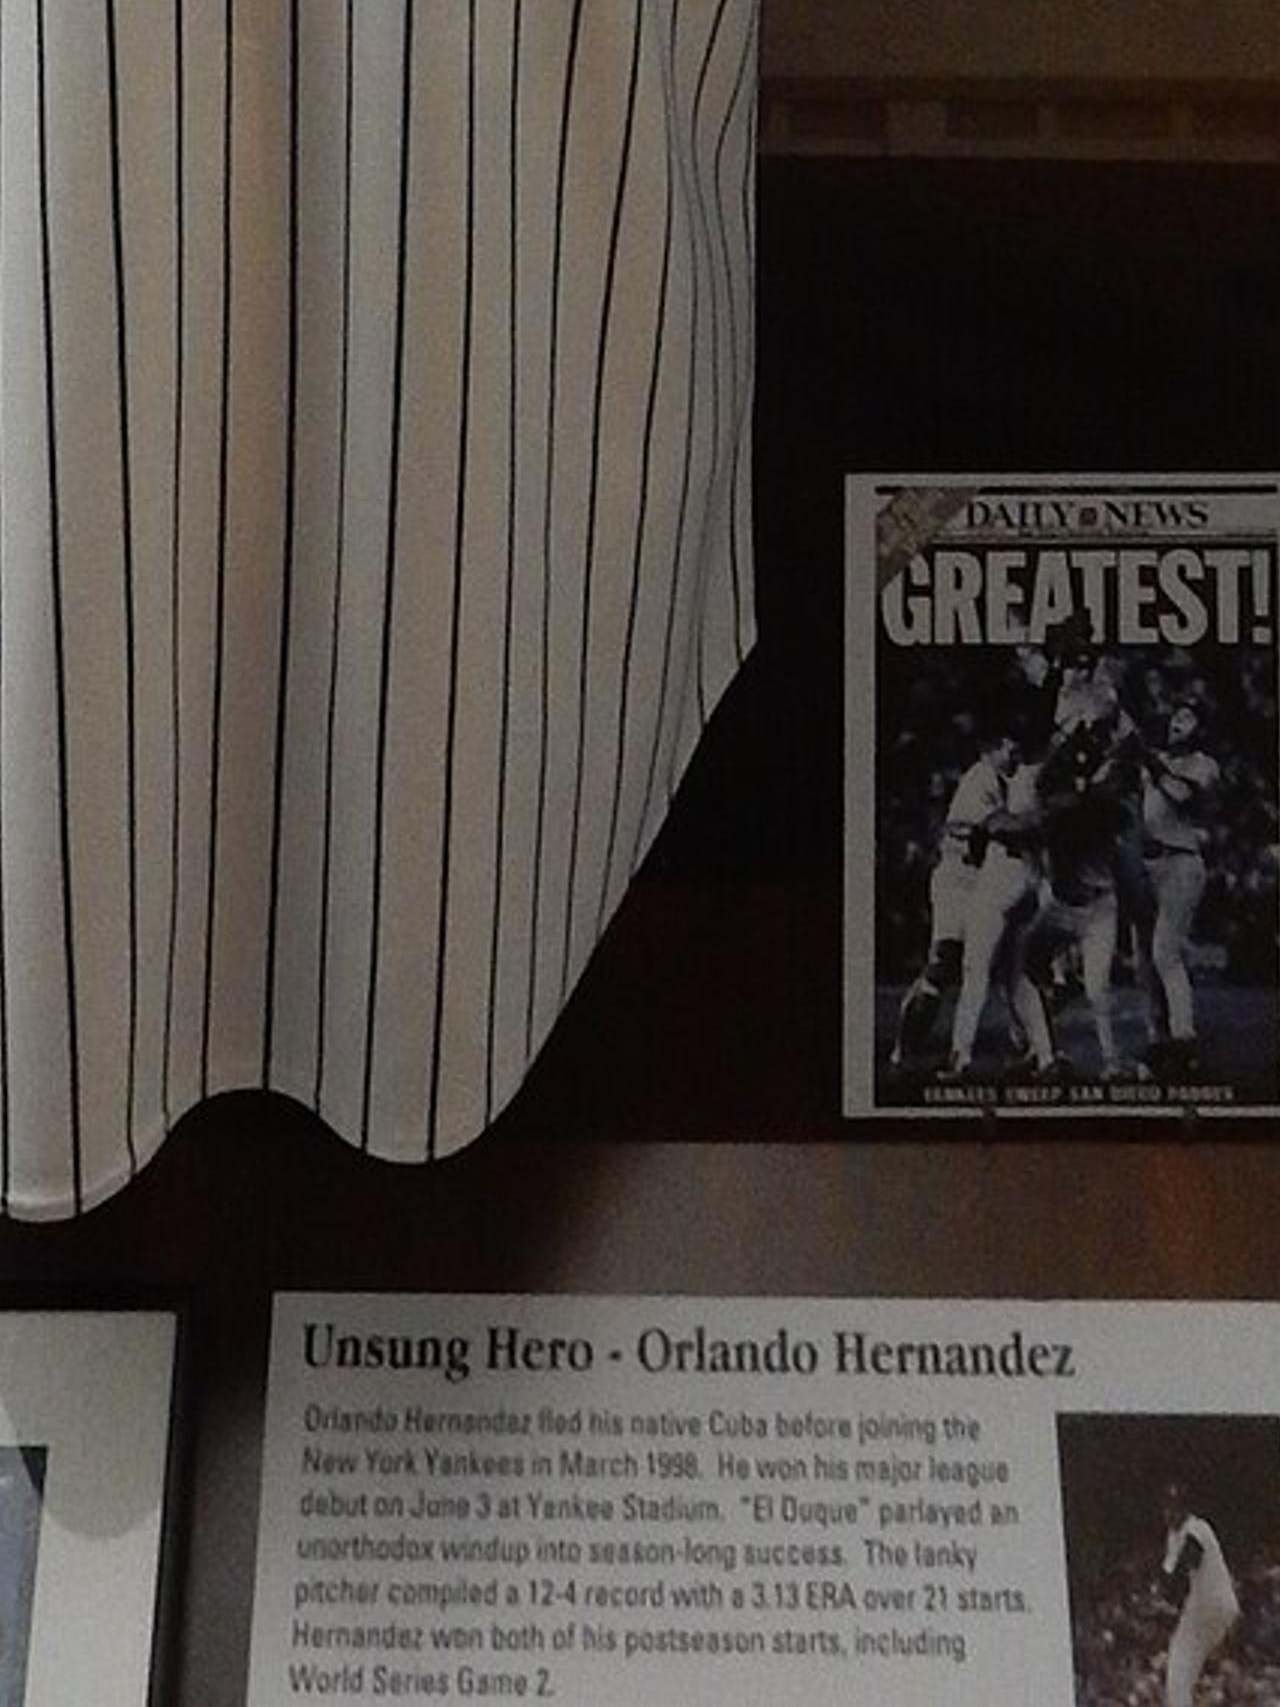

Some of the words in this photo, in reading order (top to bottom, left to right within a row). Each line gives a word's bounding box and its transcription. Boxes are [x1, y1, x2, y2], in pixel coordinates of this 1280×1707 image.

[966, 501, 1073, 529] DAILY
[1104, 500, 1210, 529] NEWS
[882, 549, 1273, 647] GREATEST!
[304, 1323, 470, 1382] Unsung
[487, 1326, 593, 1372] Hero
[637, 1326, 818, 1374] Orlando
[834, 1331, 1075, 1377] Hernandez
[289, 1663, 364, 1695] World
[373, 1665, 449, 1696] Series
[457, 1666, 527, 1697] Game
